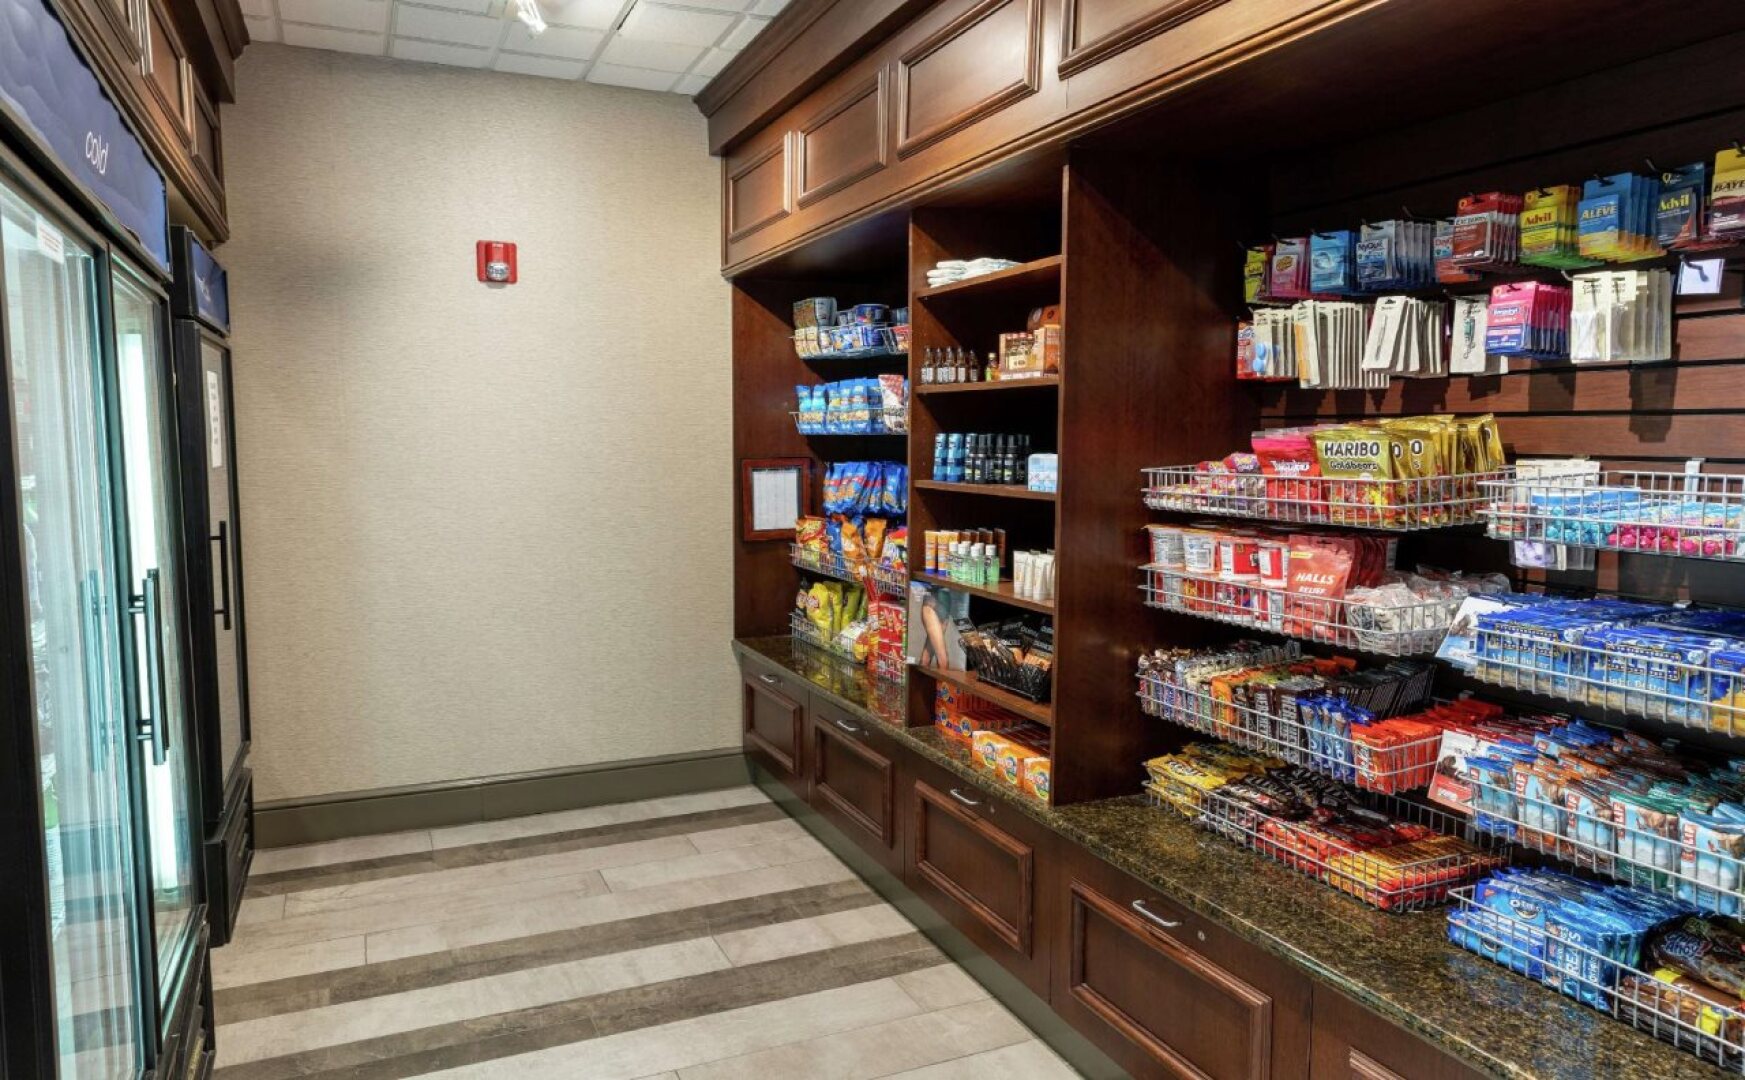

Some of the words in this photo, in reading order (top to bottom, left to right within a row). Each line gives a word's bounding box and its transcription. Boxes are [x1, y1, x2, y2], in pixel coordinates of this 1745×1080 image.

[86, 131, 109, 176] cold
[1714, 180, 1745, 193] BAYE
[1658, 194, 1690, 211] Advil
[1526, 212, 1552, 225] Advil
[1582, 205, 1617, 219] ALEVE
[1324, 442, 1381, 458] HARIBO
[1296, 573, 1335, 585] HALLS
